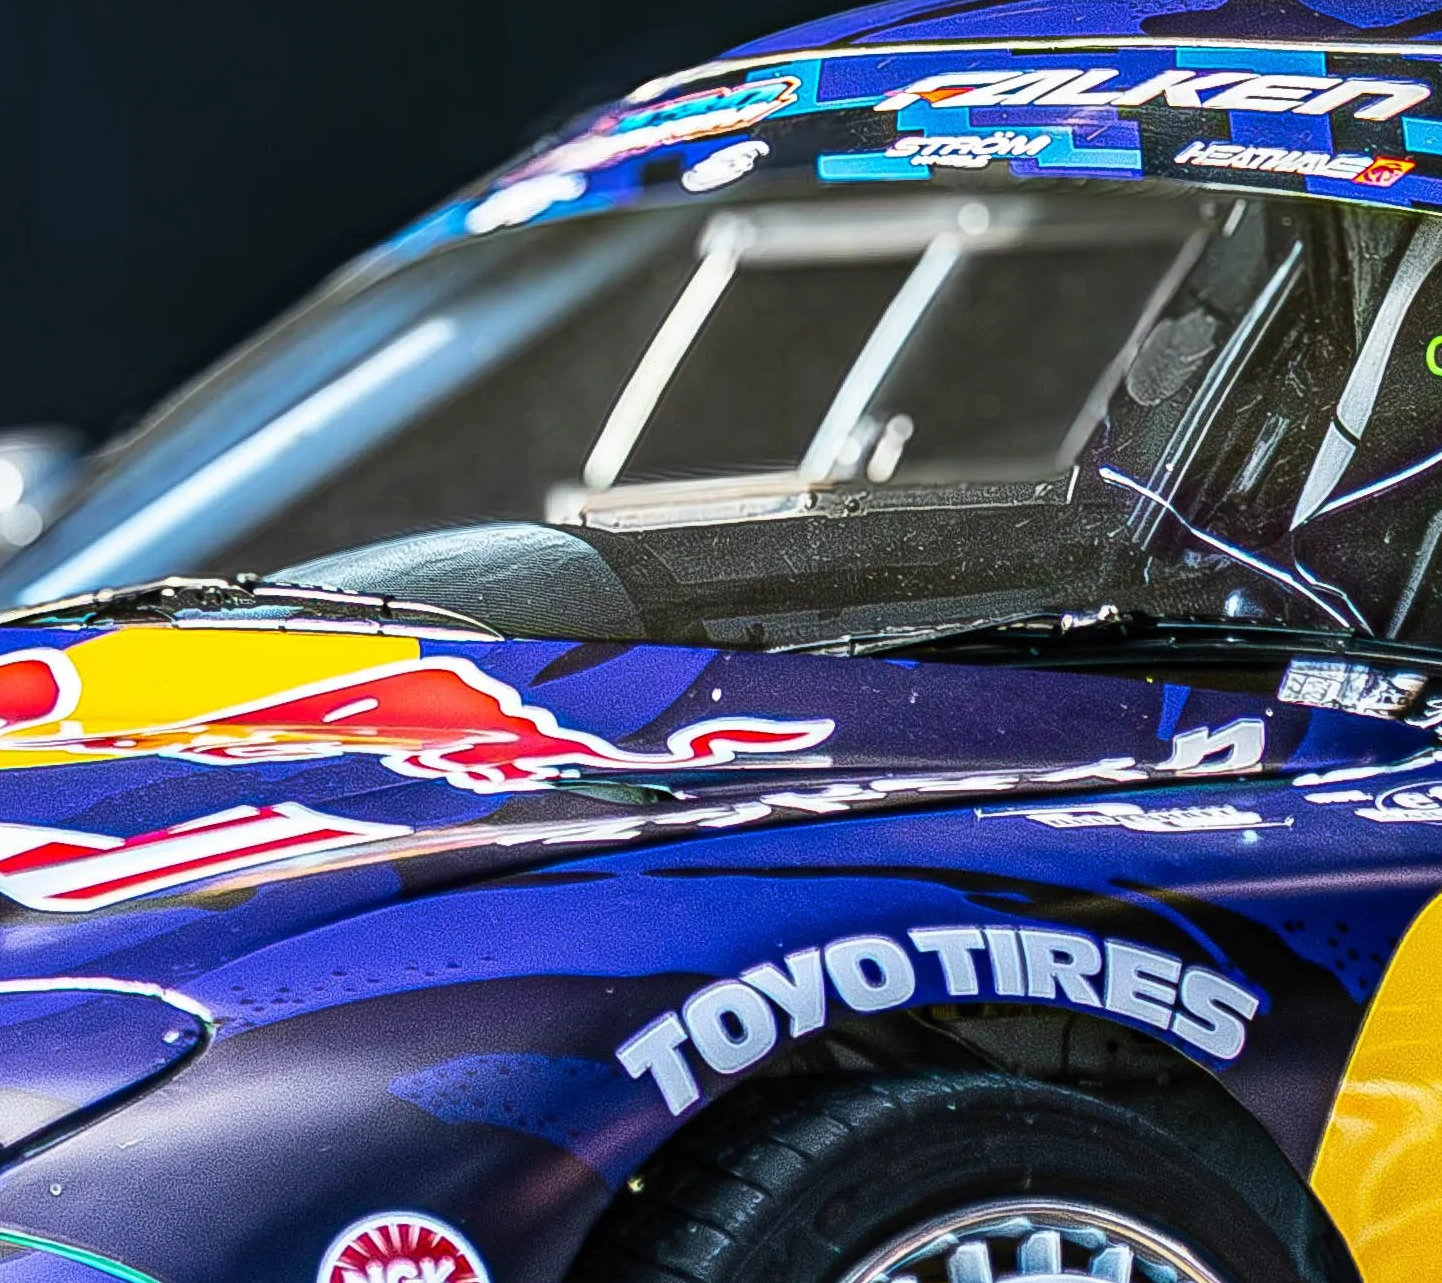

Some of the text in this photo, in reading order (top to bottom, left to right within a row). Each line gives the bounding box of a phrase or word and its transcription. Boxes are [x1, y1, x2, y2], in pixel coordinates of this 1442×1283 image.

[874, 69, 1430, 120] FALKEN
[884, 130, 1052, 158] STRÖM
[1174, 141, 1375, 180] HEATWAVE
[616, 924, 1260, 1117] TOYO TIRES
